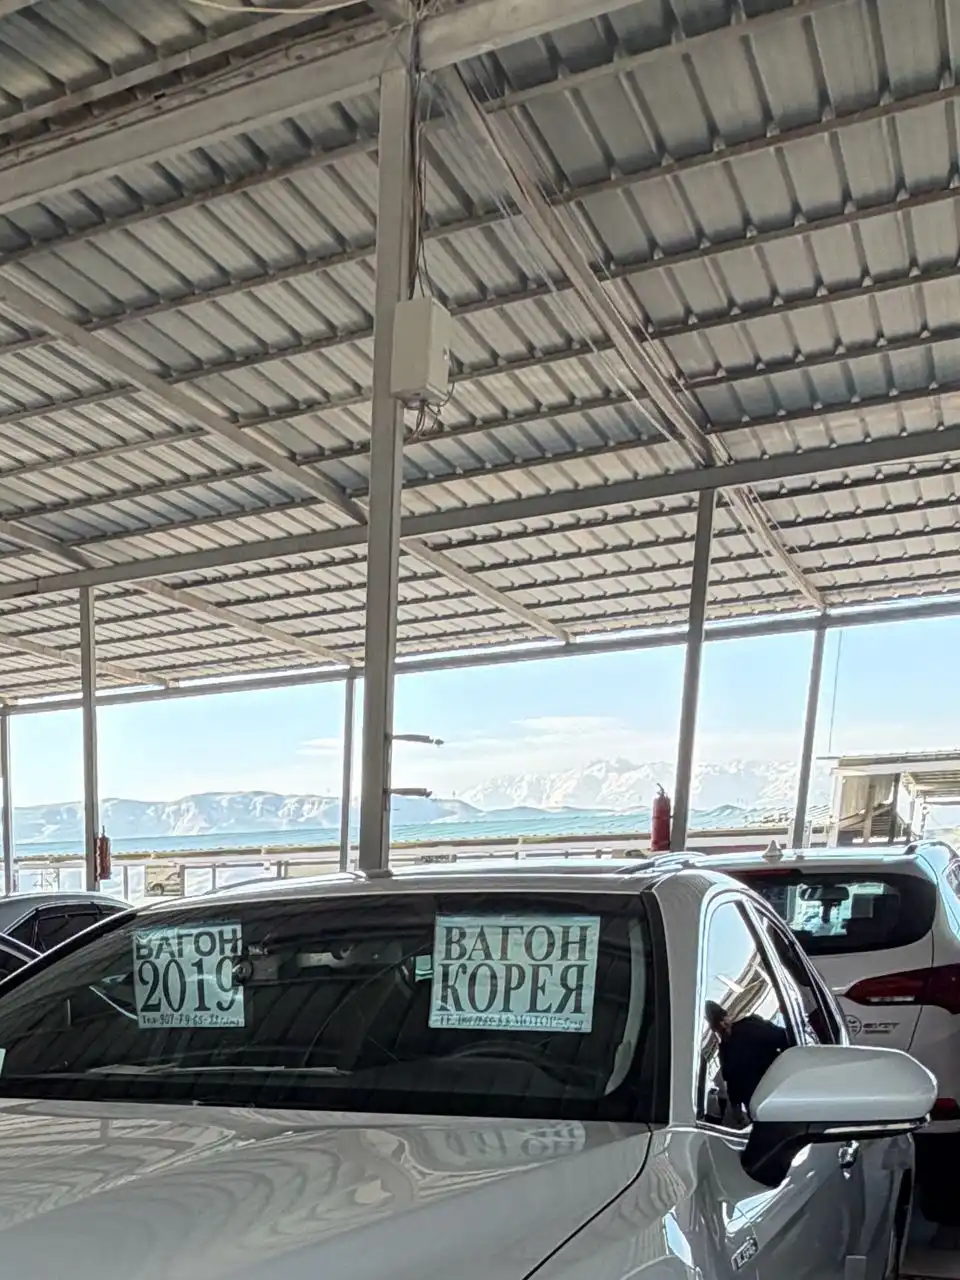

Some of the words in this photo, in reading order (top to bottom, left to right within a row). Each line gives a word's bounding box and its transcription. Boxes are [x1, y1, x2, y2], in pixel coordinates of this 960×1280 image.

[136, 928, 238, 960] ВАГОН
[443, 924, 592, 962] ВАГОН
[138, 956, 236, 1013] 2019
[436, 963, 589, 1015] КОРЕЯ
